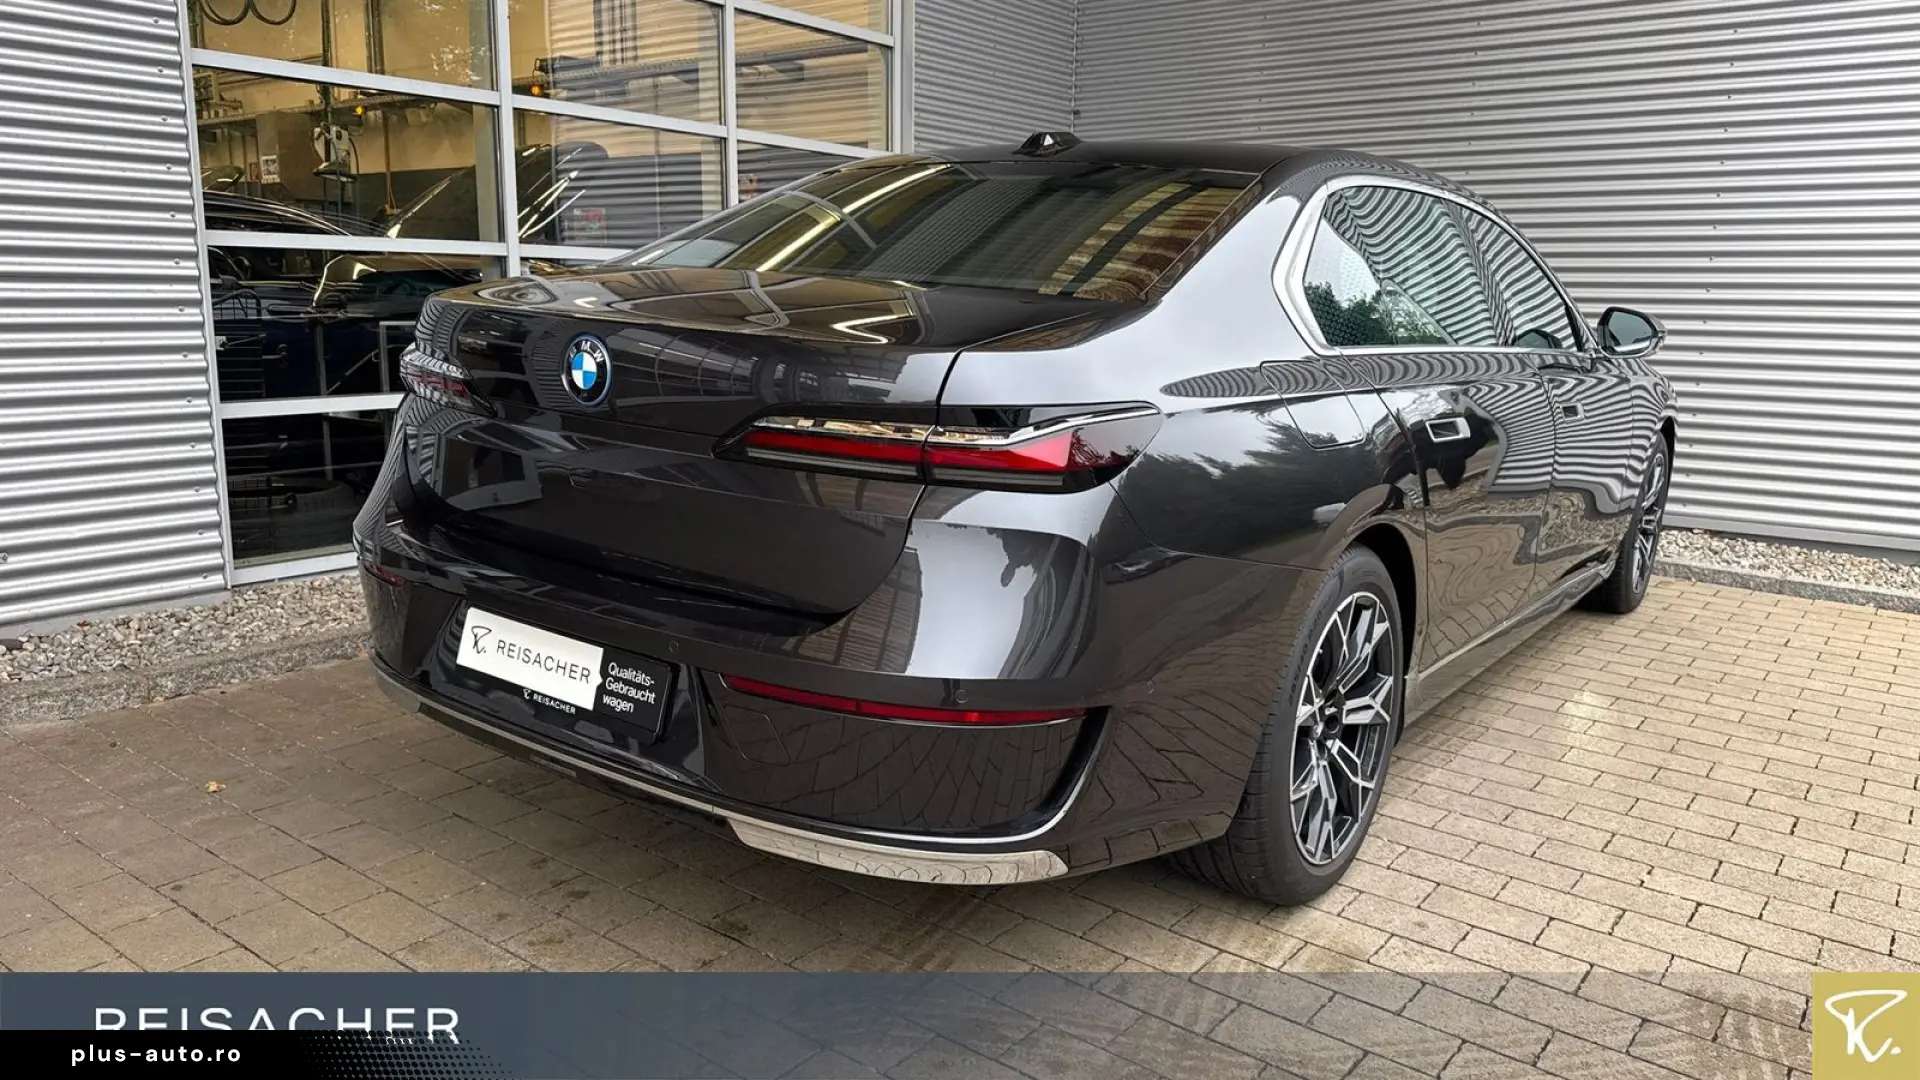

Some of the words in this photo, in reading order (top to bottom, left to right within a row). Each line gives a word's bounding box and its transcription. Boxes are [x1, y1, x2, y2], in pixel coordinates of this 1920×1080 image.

[569, 340, 604, 363] BMW
[496, 639, 592, 685] REISACHER
[608, 661, 655, 687] Qualitäts-
[602, 693, 635, 714] wagen
[605, 678, 656, 705] Gebraucht
[533, 693, 576, 715] REISACHER
